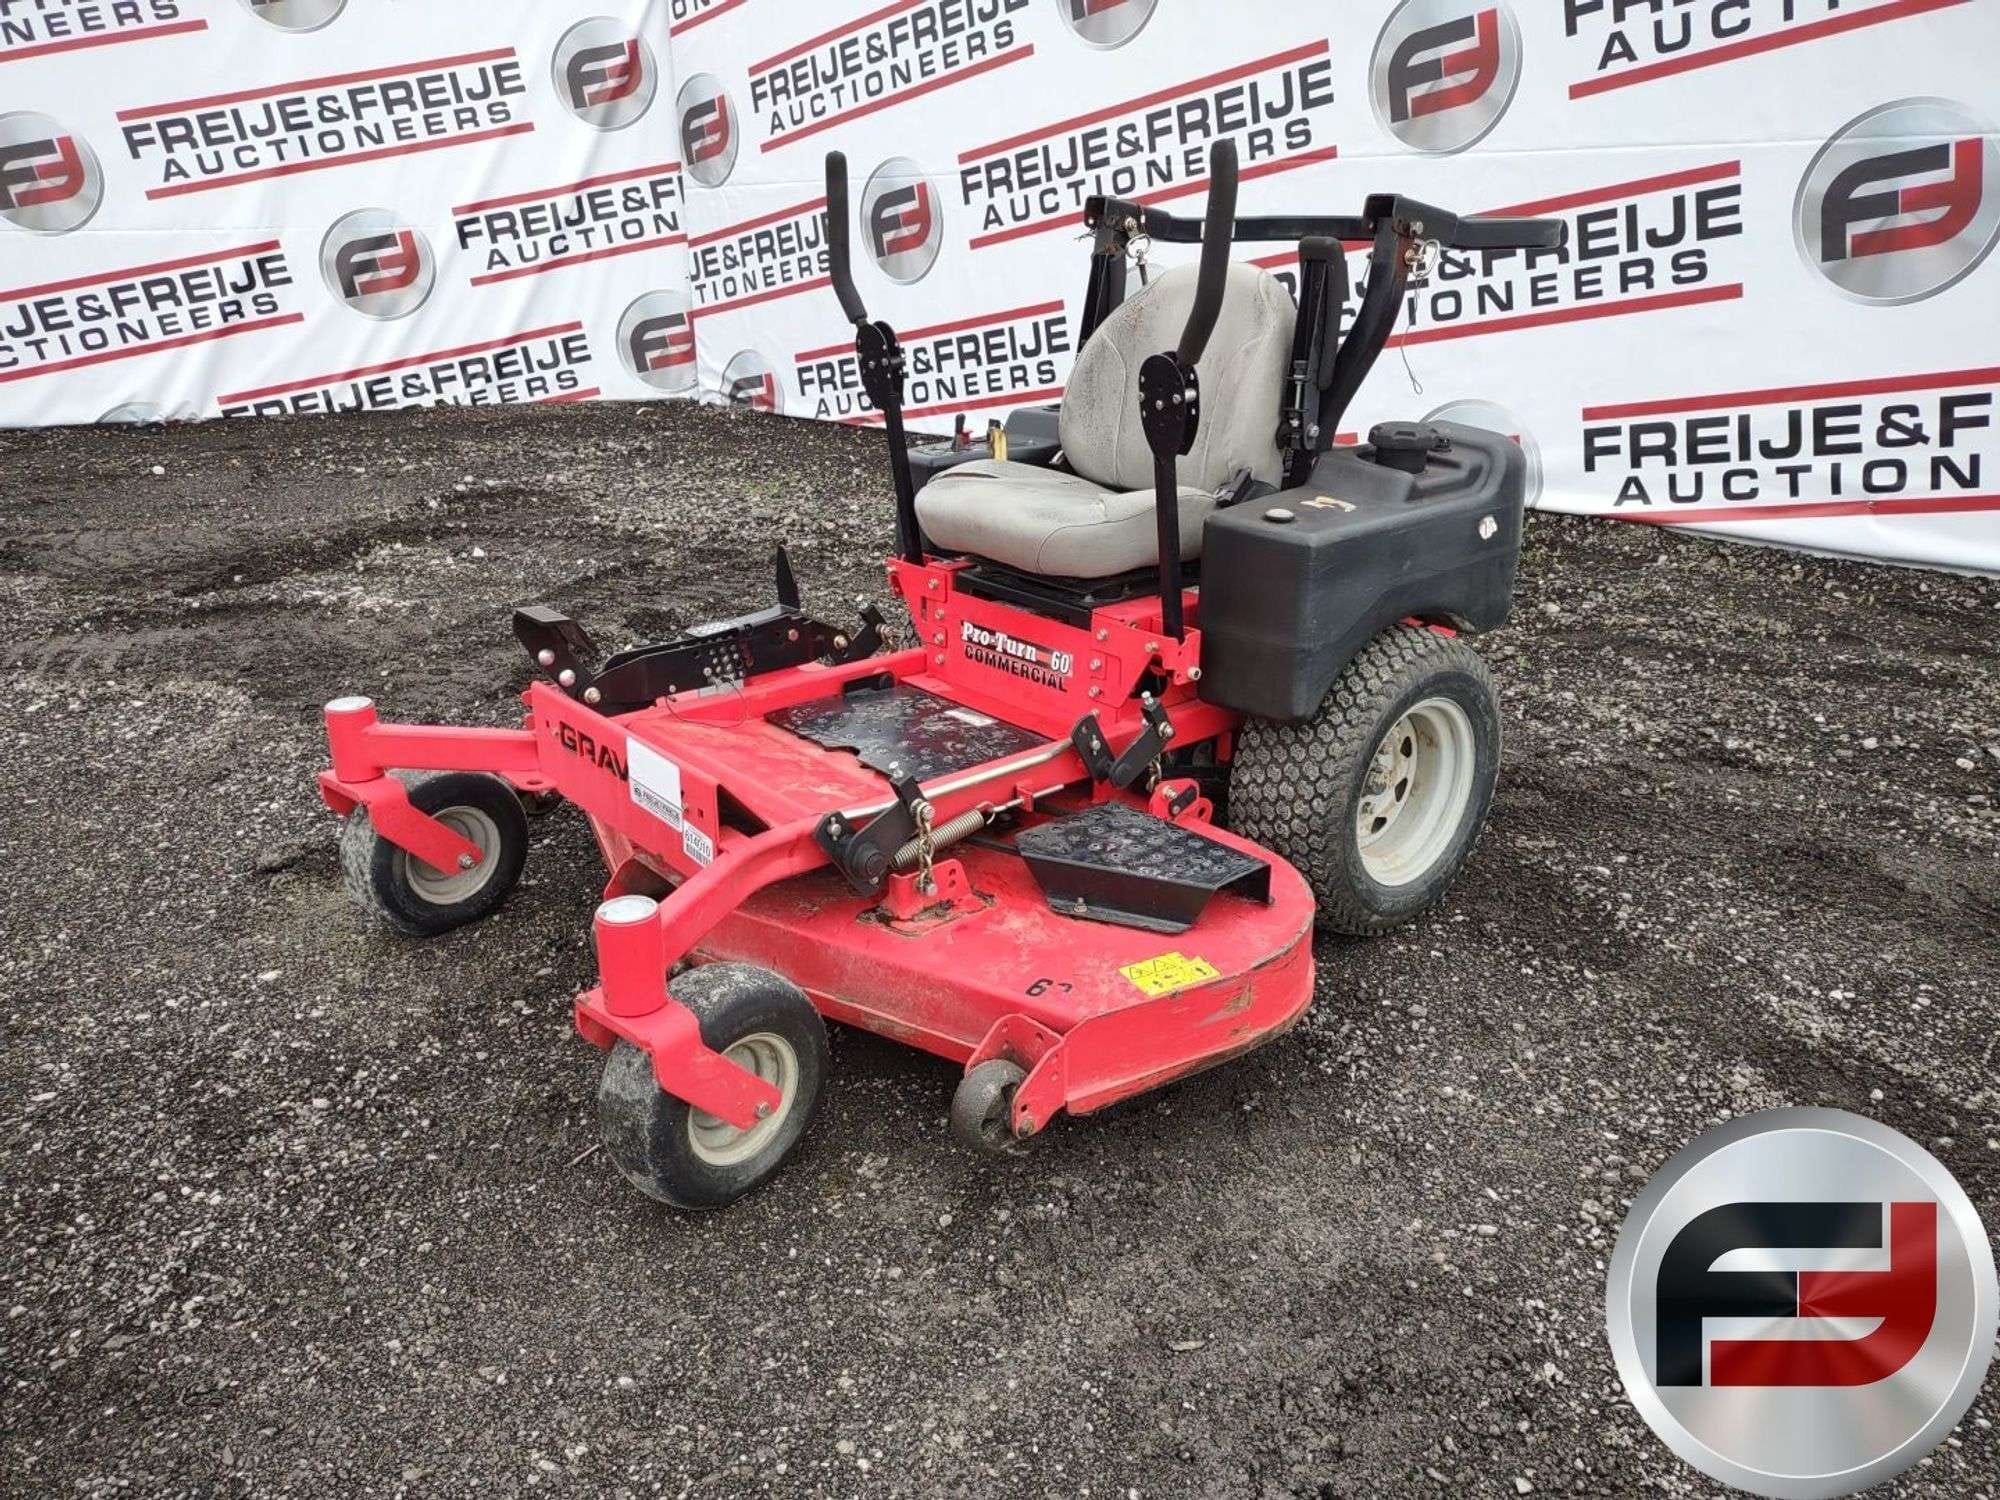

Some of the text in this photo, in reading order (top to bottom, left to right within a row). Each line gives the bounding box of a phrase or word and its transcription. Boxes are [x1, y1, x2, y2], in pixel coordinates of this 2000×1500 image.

[121, 61, 526, 160] FREIJE&FREIJE
[770, 20, 1014, 136] AUCTIONEERS
[163, 101, 512, 183] AUCTIONEERS
[961, 59, 1335, 205] FREIJE&FREIJE
[455, 175, 684, 250] FREIJE&F
[983, 117, 1312, 231] AUCTIONERS
[486, 211, 680, 271] AUCTION
[0, 254, 293, 341] JE&FREIJE
[815, 359, 1057, 419] AUCONEERS
[1582, 392, 1992, 472] FREIJE&F
[1613, 454, 1981, 507] AUCTION
[965, 645, 1068, 693] COMMERCIAL
[1051, 651, 1072, 675] 60
